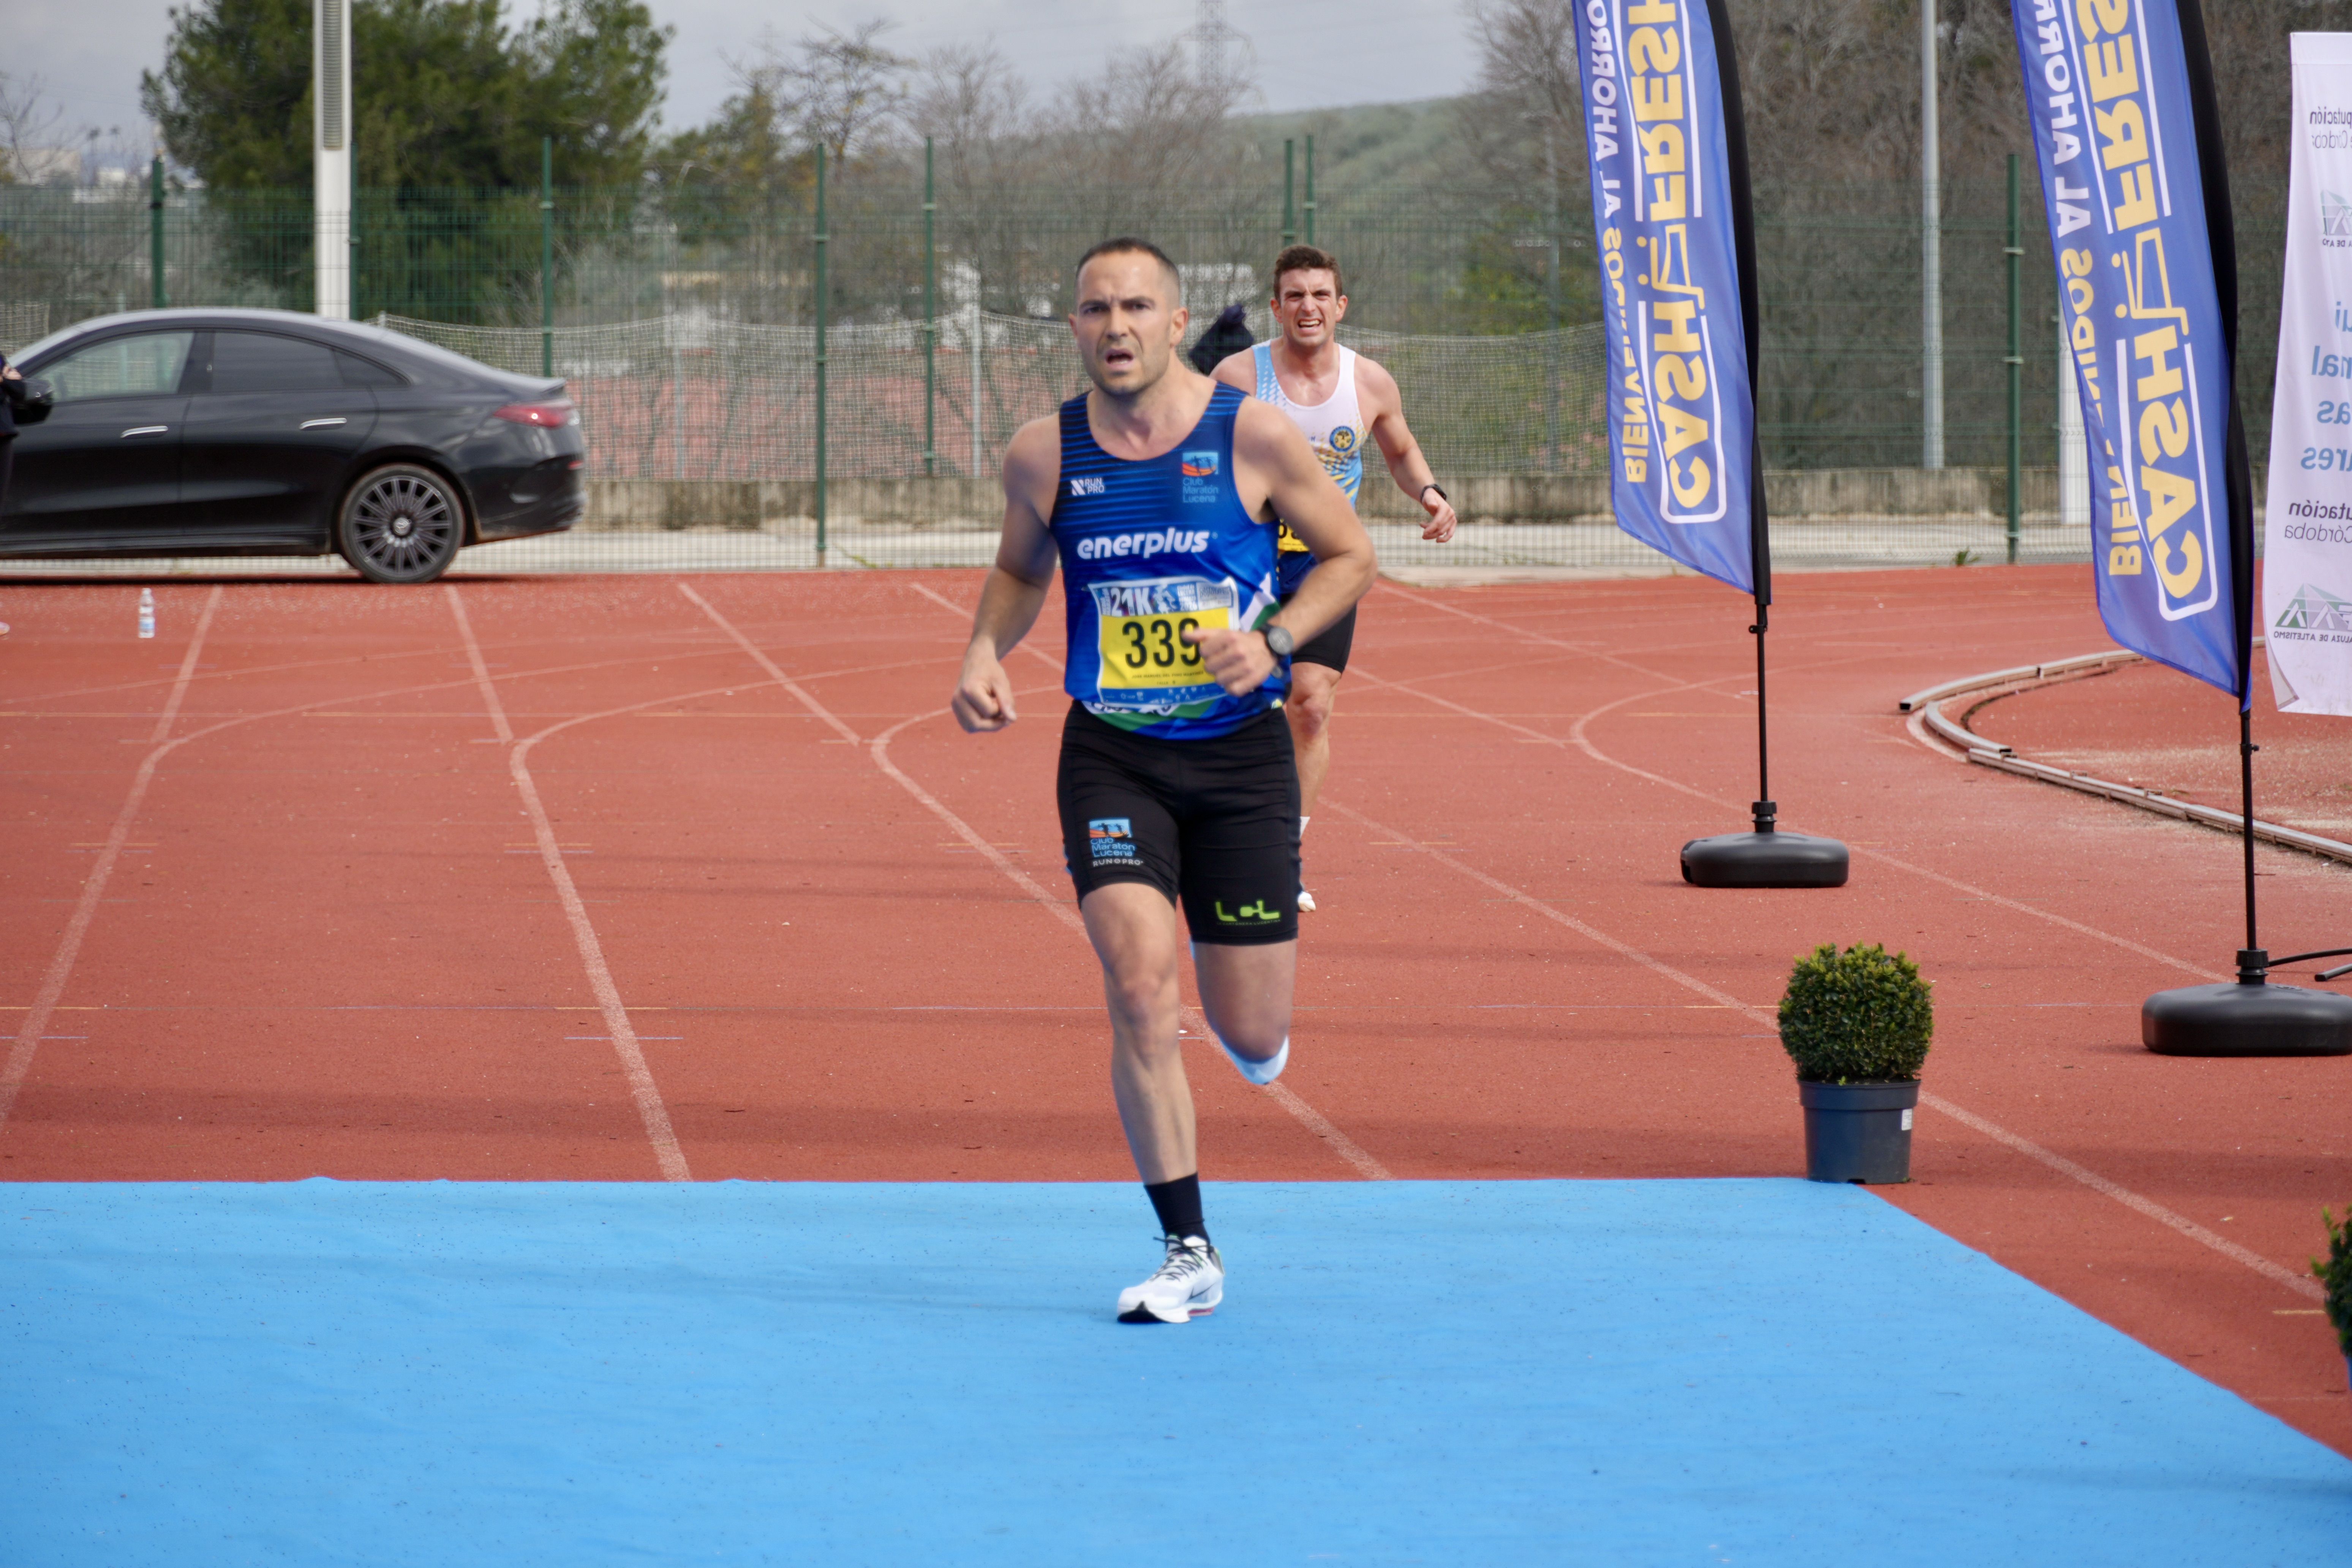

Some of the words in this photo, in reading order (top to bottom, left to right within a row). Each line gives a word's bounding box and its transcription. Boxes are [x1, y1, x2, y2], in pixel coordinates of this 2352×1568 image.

[1085, 477, 1102, 487] RUN
[1182, 477, 1204, 486] Club
[1087, 485, 1105, 494] PRO
[1182, 485, 1219, 494] Maratón
[1182, 495, 1216, 503] Lucena
[1077, 526, 1210, 560] enerplus
[1111, 587, 1154, 617] 21K
[1122, 618, 1201, 669] 339
[1092, 842, 1135, 851] Maratón
[1092, 849, 1133, 857] Lucena
[1093, 858, 1113, 867] RUN
